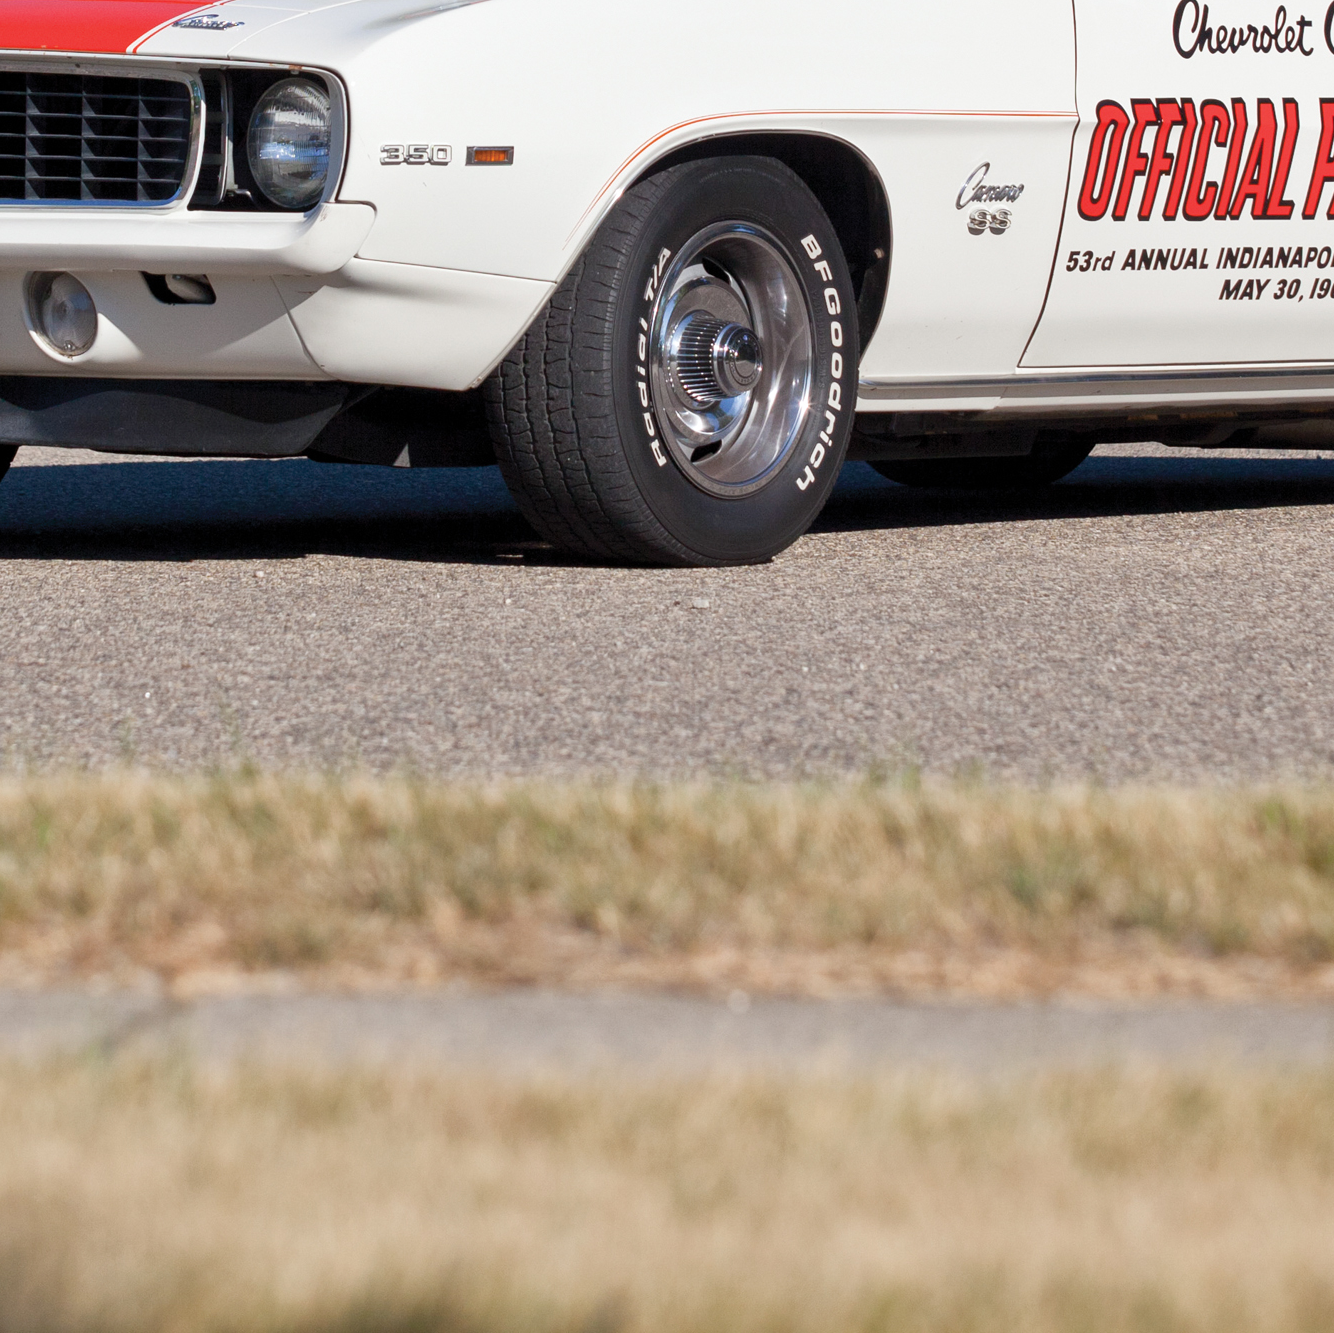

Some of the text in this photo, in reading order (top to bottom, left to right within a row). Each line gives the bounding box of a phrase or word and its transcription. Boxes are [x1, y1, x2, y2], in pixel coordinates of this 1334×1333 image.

[380, 144, 452, 166] 350
[1077, 97, 1300, 222] OFFICIAL
[967, 209, 1012, 235] SS
[1065, 250, 1116, 273] 53rd
[1120, 248, 1209, 271] ANNUAL
[1218, 279, 1271, 301] MAY
[1273, 279, 1304, 303] 30,
[636, 247, 671, 467] Radial T/A
[796, 233, 843, 491] BFGoodrich
